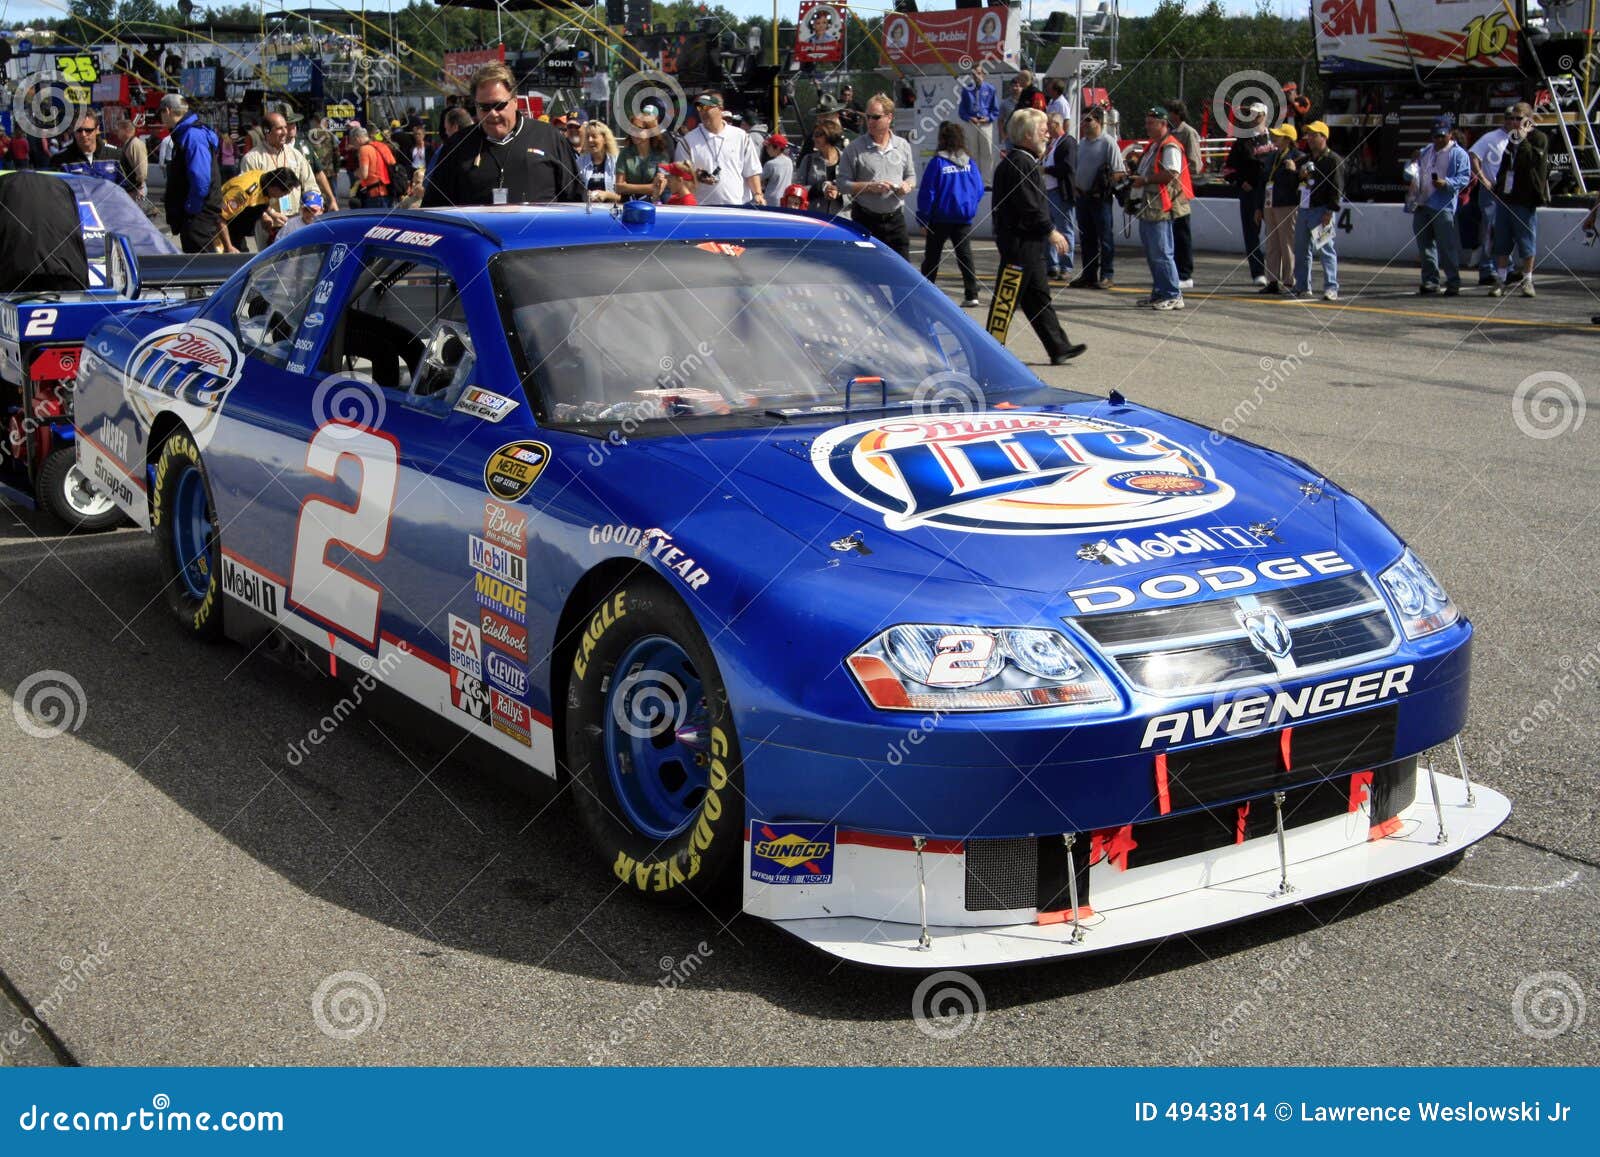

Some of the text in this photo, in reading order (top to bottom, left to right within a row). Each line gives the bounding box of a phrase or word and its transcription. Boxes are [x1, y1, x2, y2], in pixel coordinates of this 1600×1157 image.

[1321, 0, 1377, 36] 3M
[1462, 12, 1509, 62] 16
[58, 56, 97, 83] 25
[548, 59, 574, 68] SONY
[363, 226, 444, 248] KURT BUSCH
[1338, 208, 1353, 234] 4
[992, 271, 1020, 333] NEXTEL
[24, 308, 58, 337] 2
[177, 332, 230, 368] Miller
[478, 406, 499, 420] CAR
[100, 416, 128, 463] JASPER
[493, 474, 521, 491] CUP SERIES
[496, 458, 529, 479] NEXTEL
[1112, 471, 1137, 483] TRUE
[287, 418, 401, 650] 2
[485, 503, 525, 538] Bud
[472, 538, 508, 576] Mobil
[511, 556, 523, 582] 1
[1104, 527, 1226, 568] Mobil
[222, 558, 260, 609] Mobil
[263, 581, 277, 616] 1
[474, 571, 527, 615] MOOG
[1066, 550, 1355, 614] DODGE
[451, 620, 479, 659] EA
[481, 615, 527, 654] Edelbrock
[573, 590, 627, 681] EAGLE
[450, 648, 480, 675] SPORTS
[487, 651, 526, 691] CLEVITE
[925, 633, 997, 684] 2
[497, 694, 524, 723] Rally's
[1140, 664, 1414, 750] AVENGER
[757, 842, 829, 859] SUNOCO
